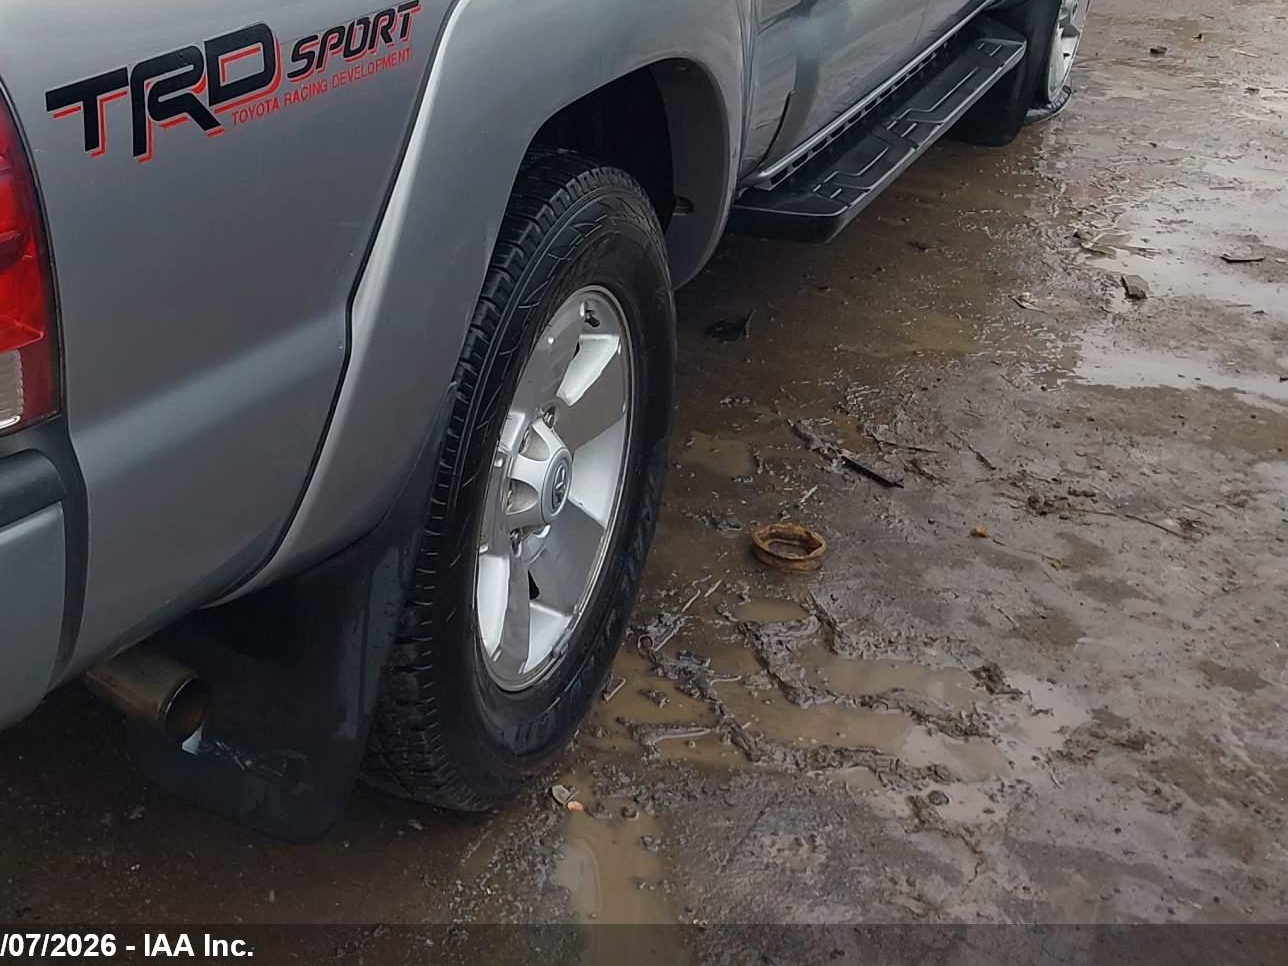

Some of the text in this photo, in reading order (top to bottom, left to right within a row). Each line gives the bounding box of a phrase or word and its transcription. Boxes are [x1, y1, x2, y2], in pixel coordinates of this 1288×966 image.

[45, 0, 422, 164] TRD SPORT
[231, 48, 411, 126] TOYOTA RACING DEVELOPMENT
